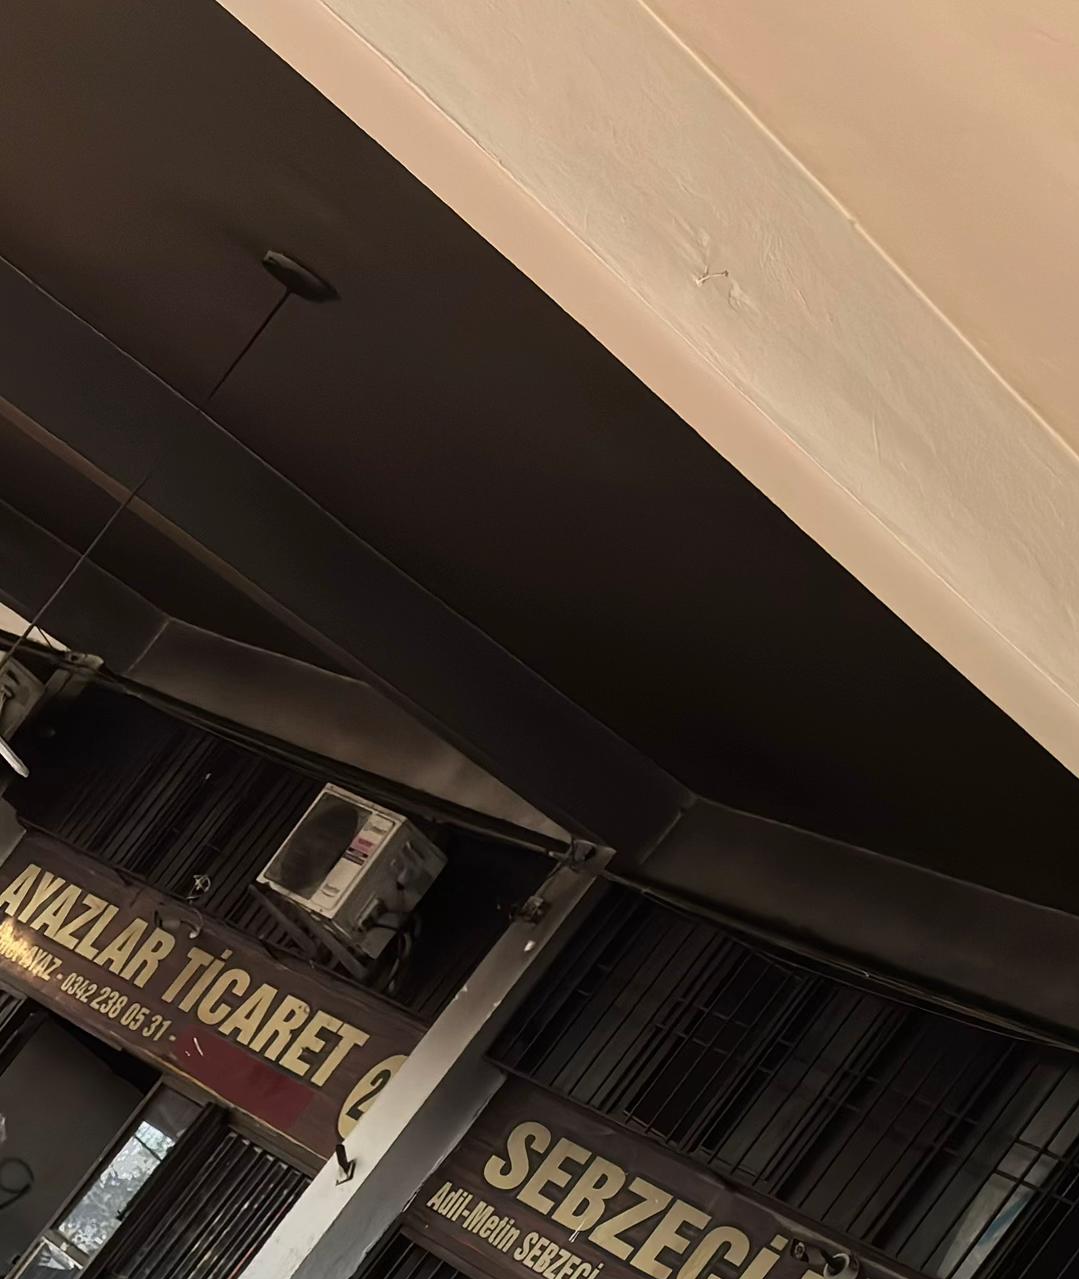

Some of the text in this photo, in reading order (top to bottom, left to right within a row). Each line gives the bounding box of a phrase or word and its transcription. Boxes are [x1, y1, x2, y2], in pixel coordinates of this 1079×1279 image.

[0, 863, 176, 989] AYAZLAR
[161, 949, 370, 1087] TİCARET
[61, 972, 98, 1003] 0342
[90, 986, 129, 1019] 238
[120, 1002, 151, 1031] 05
[142, 1014, 172, 1041] 31
[426, 1181, 520, 1253] Adil-Metin
